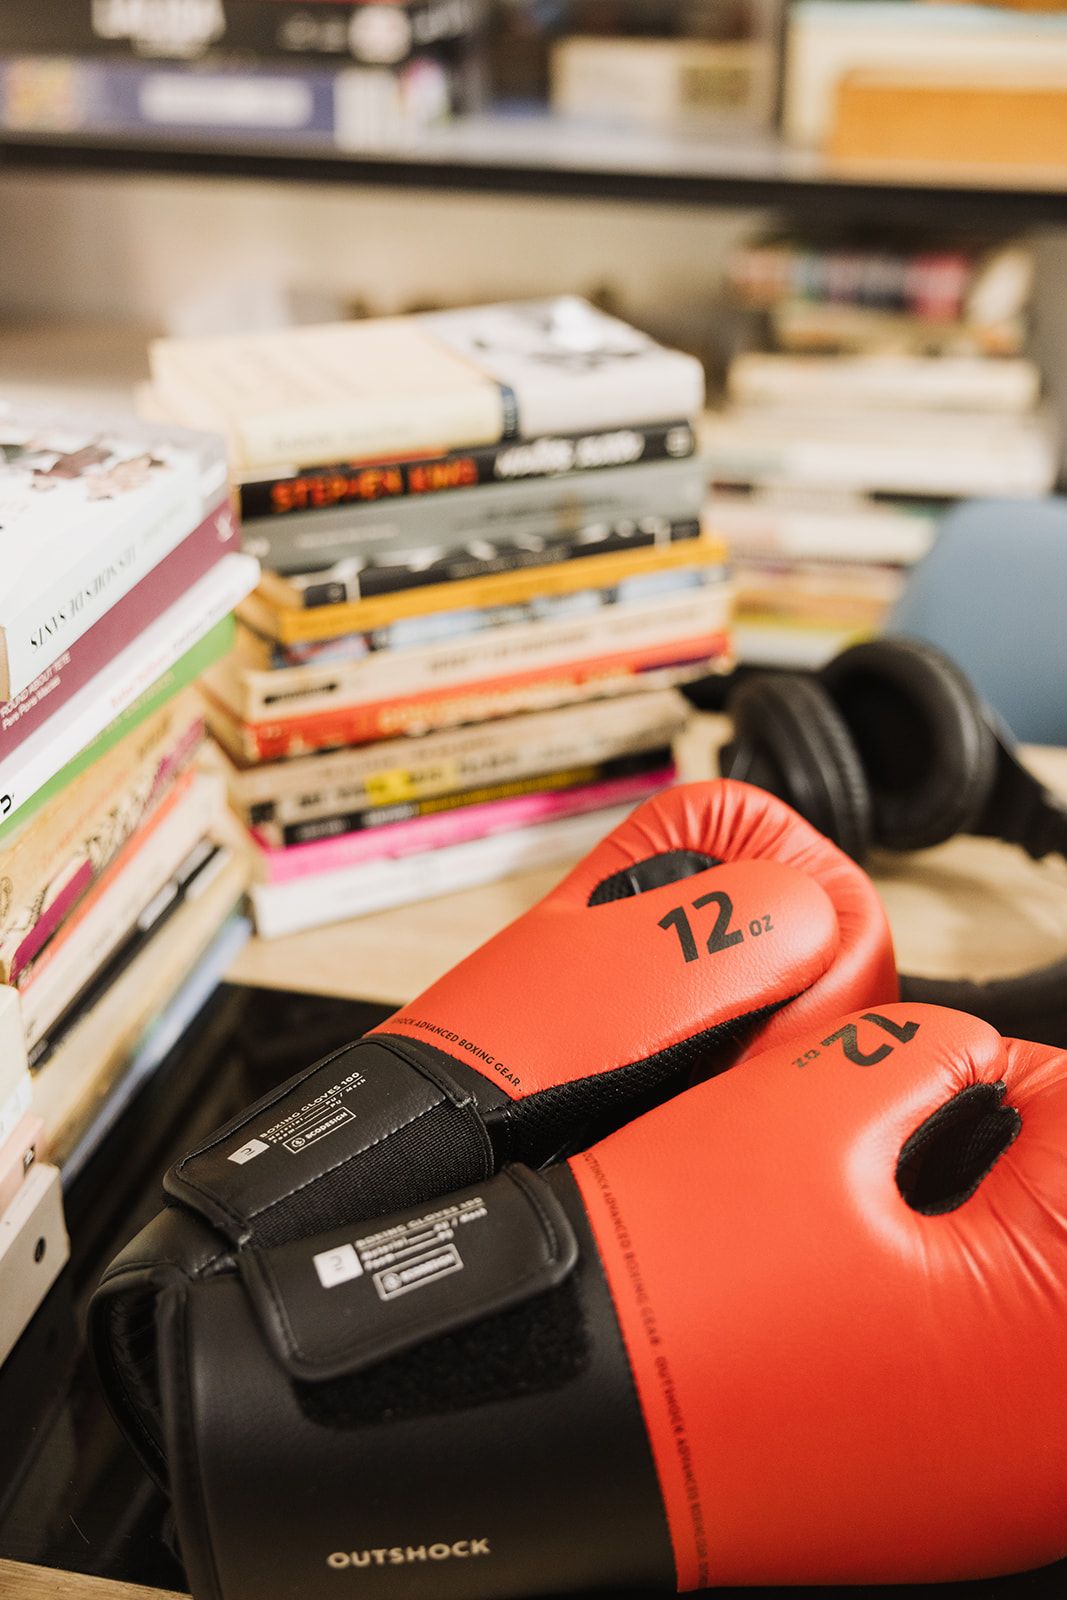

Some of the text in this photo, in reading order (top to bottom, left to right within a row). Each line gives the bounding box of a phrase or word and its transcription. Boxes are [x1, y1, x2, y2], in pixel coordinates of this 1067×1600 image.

[658, 891, 744, 963] 12
[414, 1019, 460, 1043] ADVANCED
[458, 1039, 495, 1066] BOXING
[494, 1062, 521, 1087] GEAR
[820, 1013, 921, 1067] 12
[259, 1072, 360, 1138] BOXING GLOVES 100
[604, 1192, 632, 1249] ADVANCED
[326, 1538, 491, 1569] OUTSHOCK
